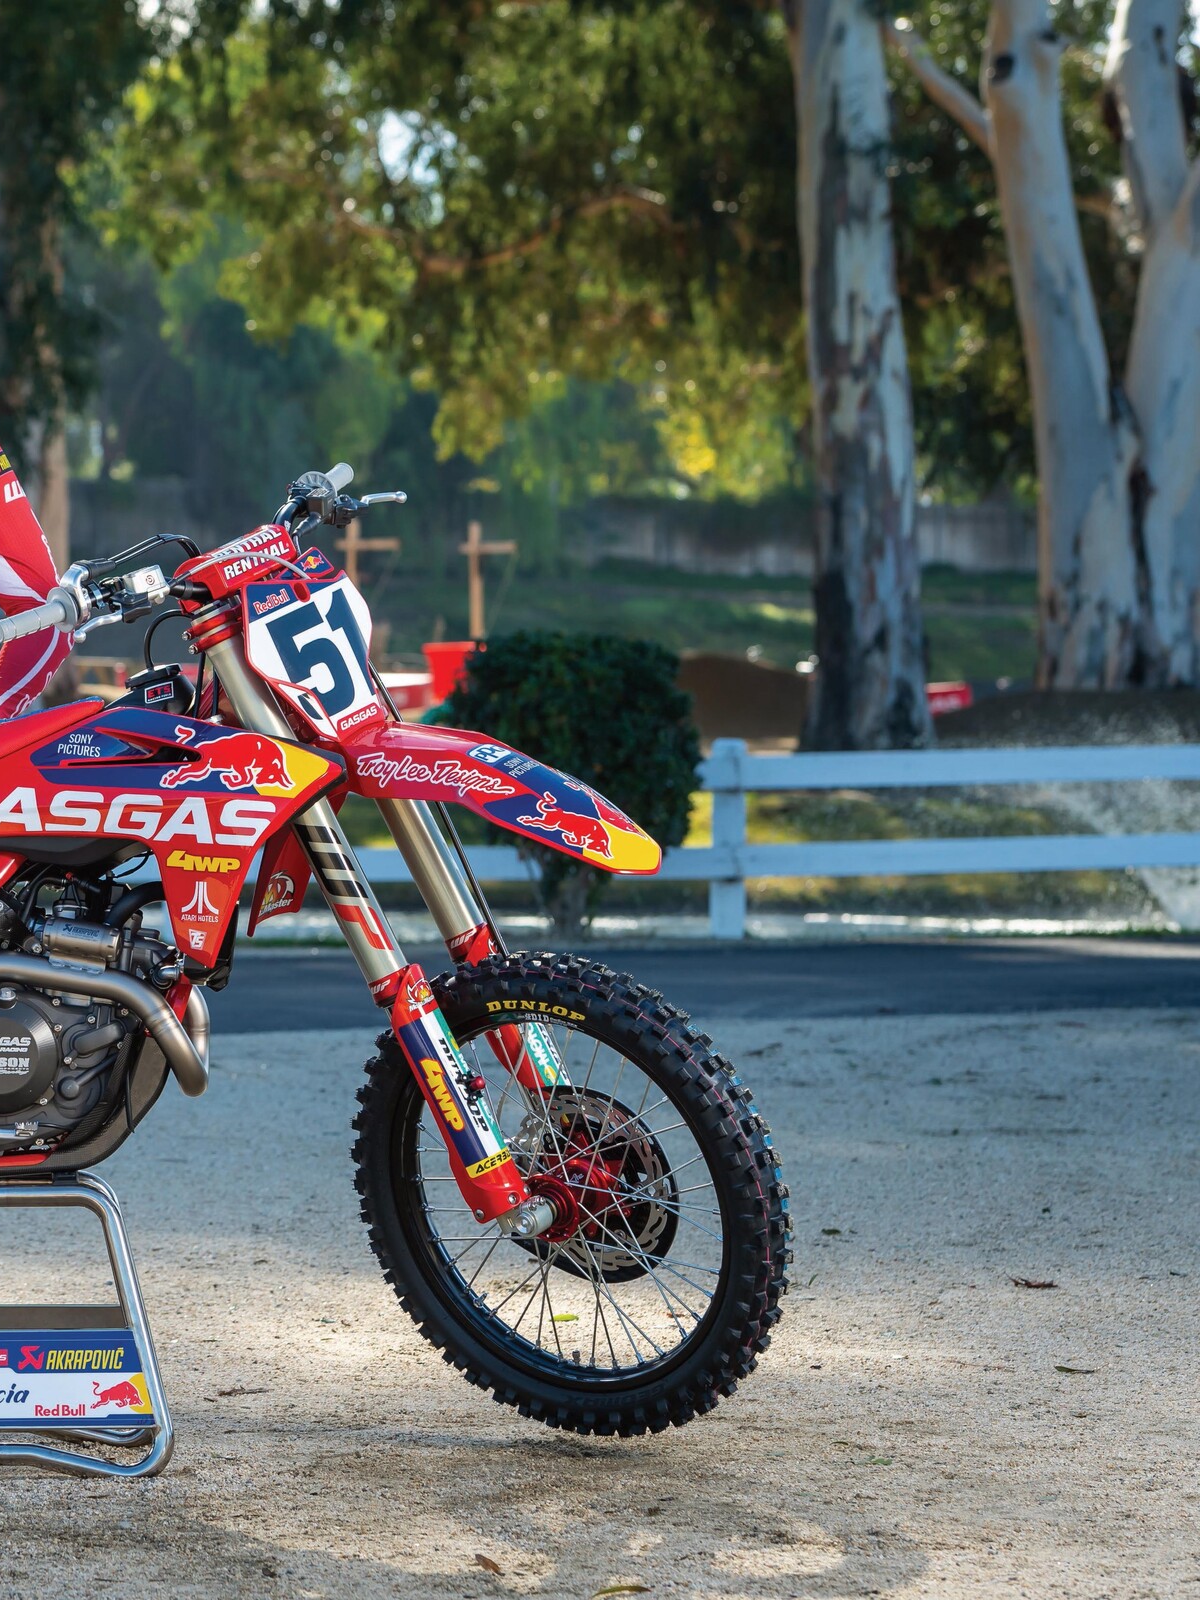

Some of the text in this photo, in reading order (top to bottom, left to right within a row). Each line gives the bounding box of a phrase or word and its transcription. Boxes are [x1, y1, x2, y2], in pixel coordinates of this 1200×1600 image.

[223, 540, 290, 581] RENTHAL
[252, 587, 291, 616] Red Bull
[265, 587, 377, 721] 51
[147, 684, 172, 699] ETS
[340, 705, 378, 731] GASGAS
[57, 743, 101, 758] PICTURES
[69, 733, 94, 745] SONY
[357, 751, 516, 797] Troy Lee Designs
[166, 849, 241, 873] 4WP
[181, 913, 219, 923] ATARI HOTELS
[486, 1000, 586, 1021] DUNLOP
[419, 1057, 464, 1132] 4WP
[34, 1403, 87, 1417] Red Bull
